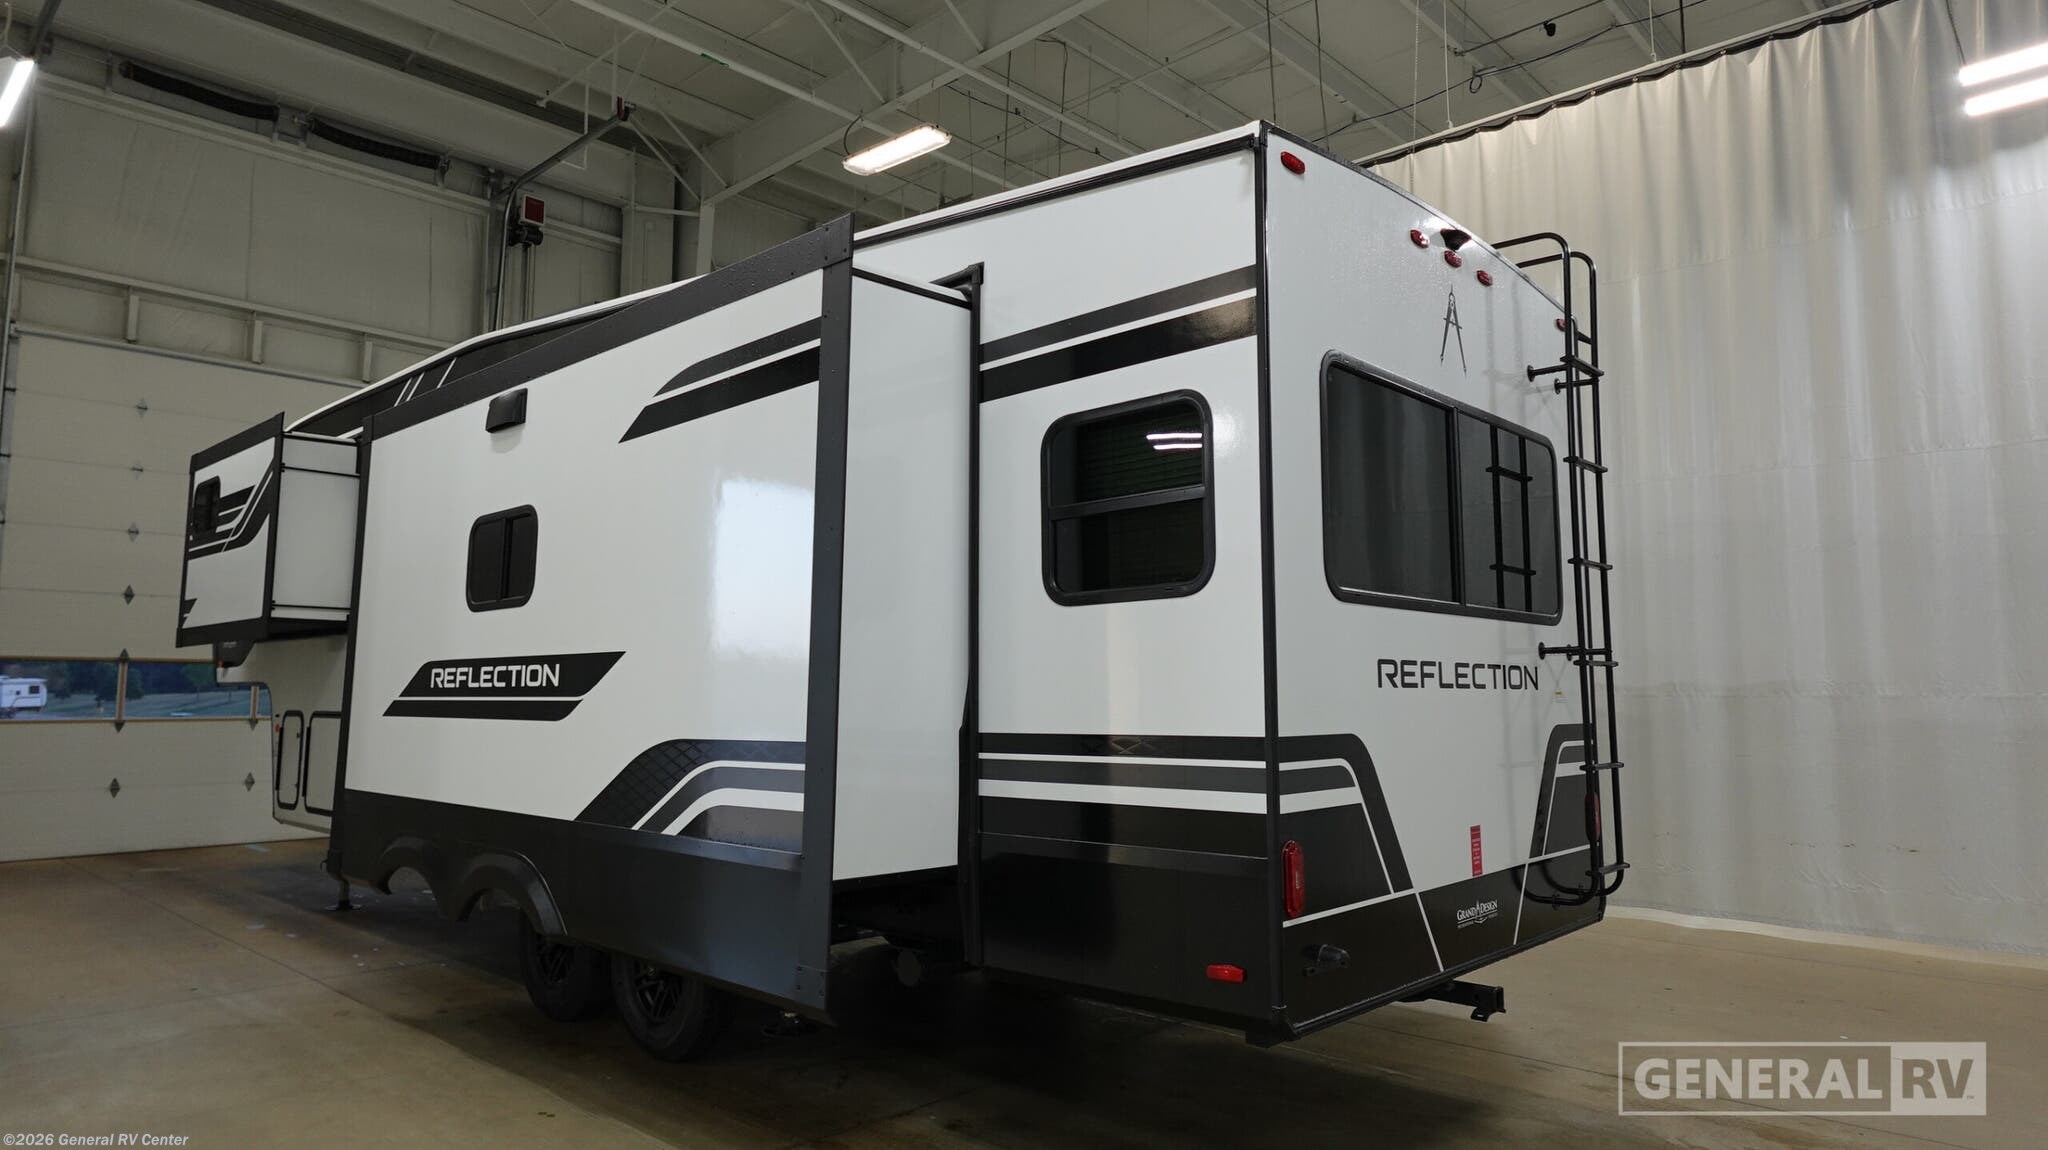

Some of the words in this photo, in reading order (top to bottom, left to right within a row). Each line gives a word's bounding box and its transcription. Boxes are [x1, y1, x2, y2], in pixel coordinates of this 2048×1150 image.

[430, 664, 560, 688] REFLECTION
[1377, 659, 1539, 690] REFLECTION
[1457, 907, 1477, 920] GRAND
[1480, 900, 1497, 913] DESIGN
